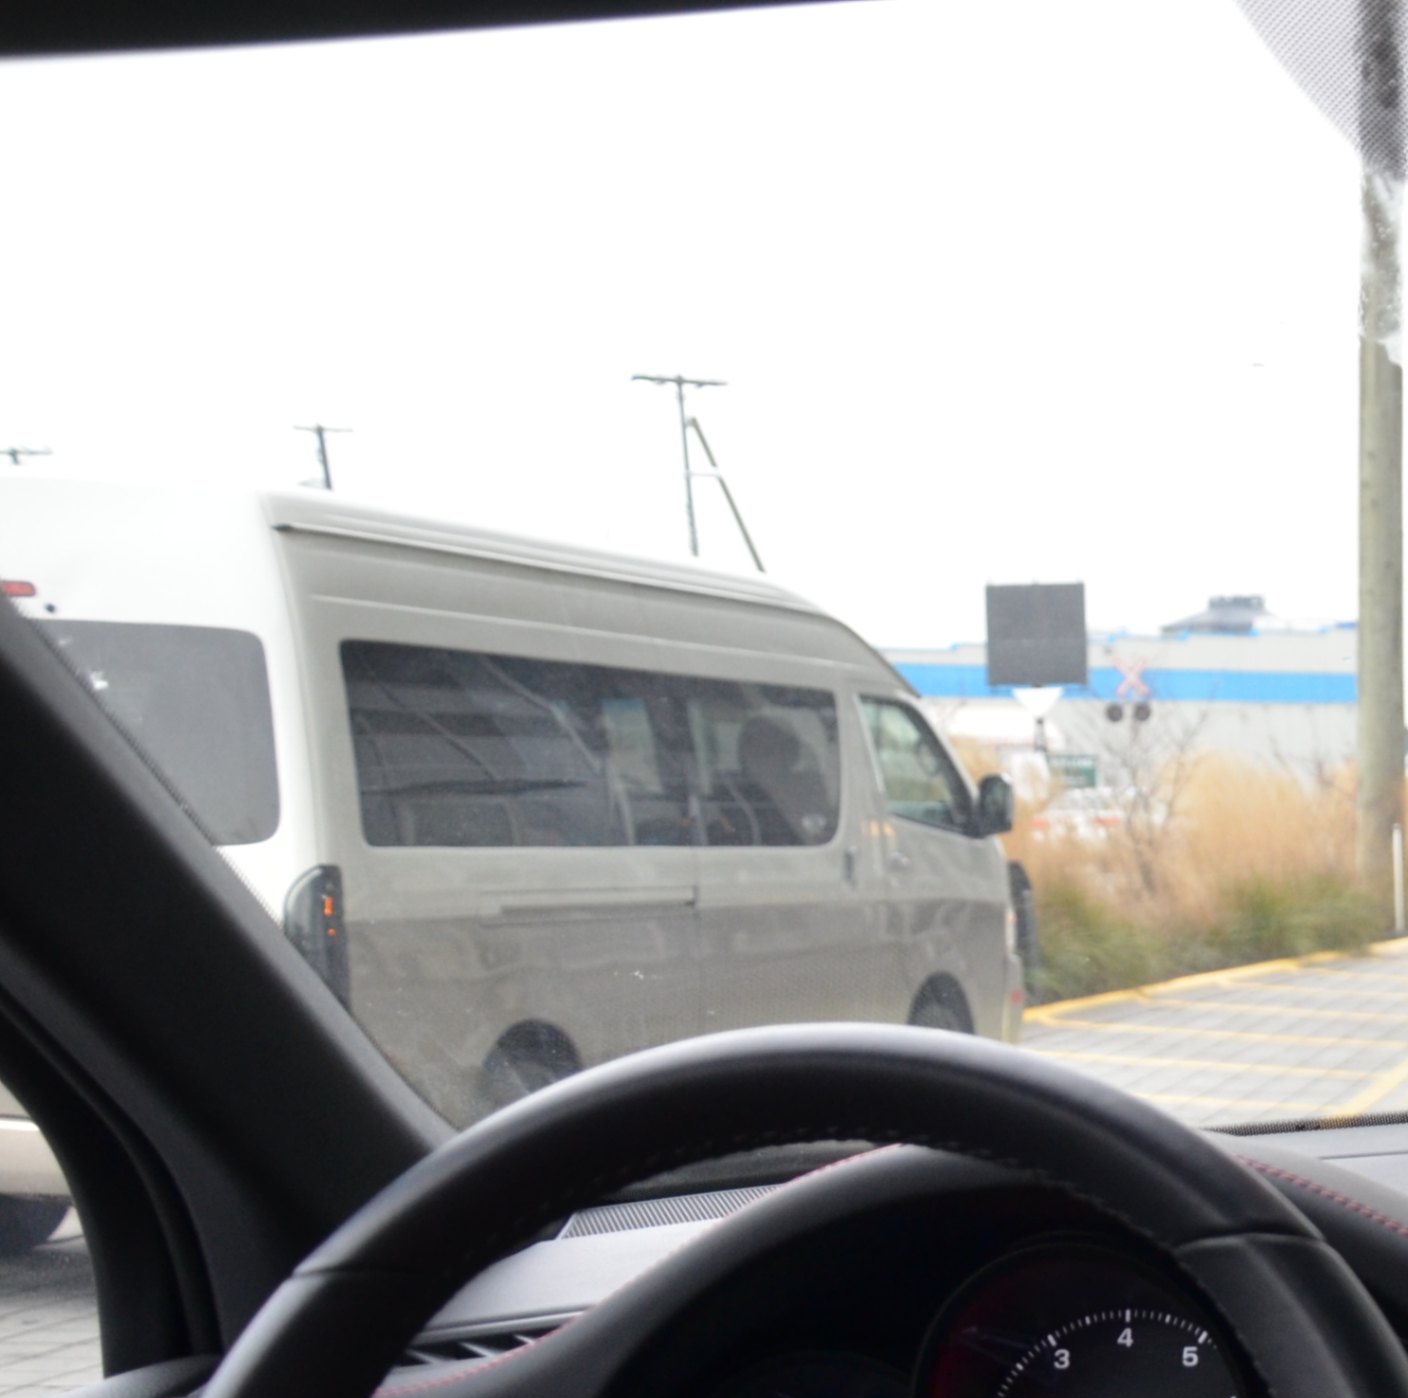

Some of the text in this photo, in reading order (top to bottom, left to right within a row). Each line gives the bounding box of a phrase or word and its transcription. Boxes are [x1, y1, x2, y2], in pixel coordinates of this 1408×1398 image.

[1118, 1328, 1133, 1348] 4
[1054, 1349, 1070, 1369] 3
[1182, 1347, 1198, 1367] 5
